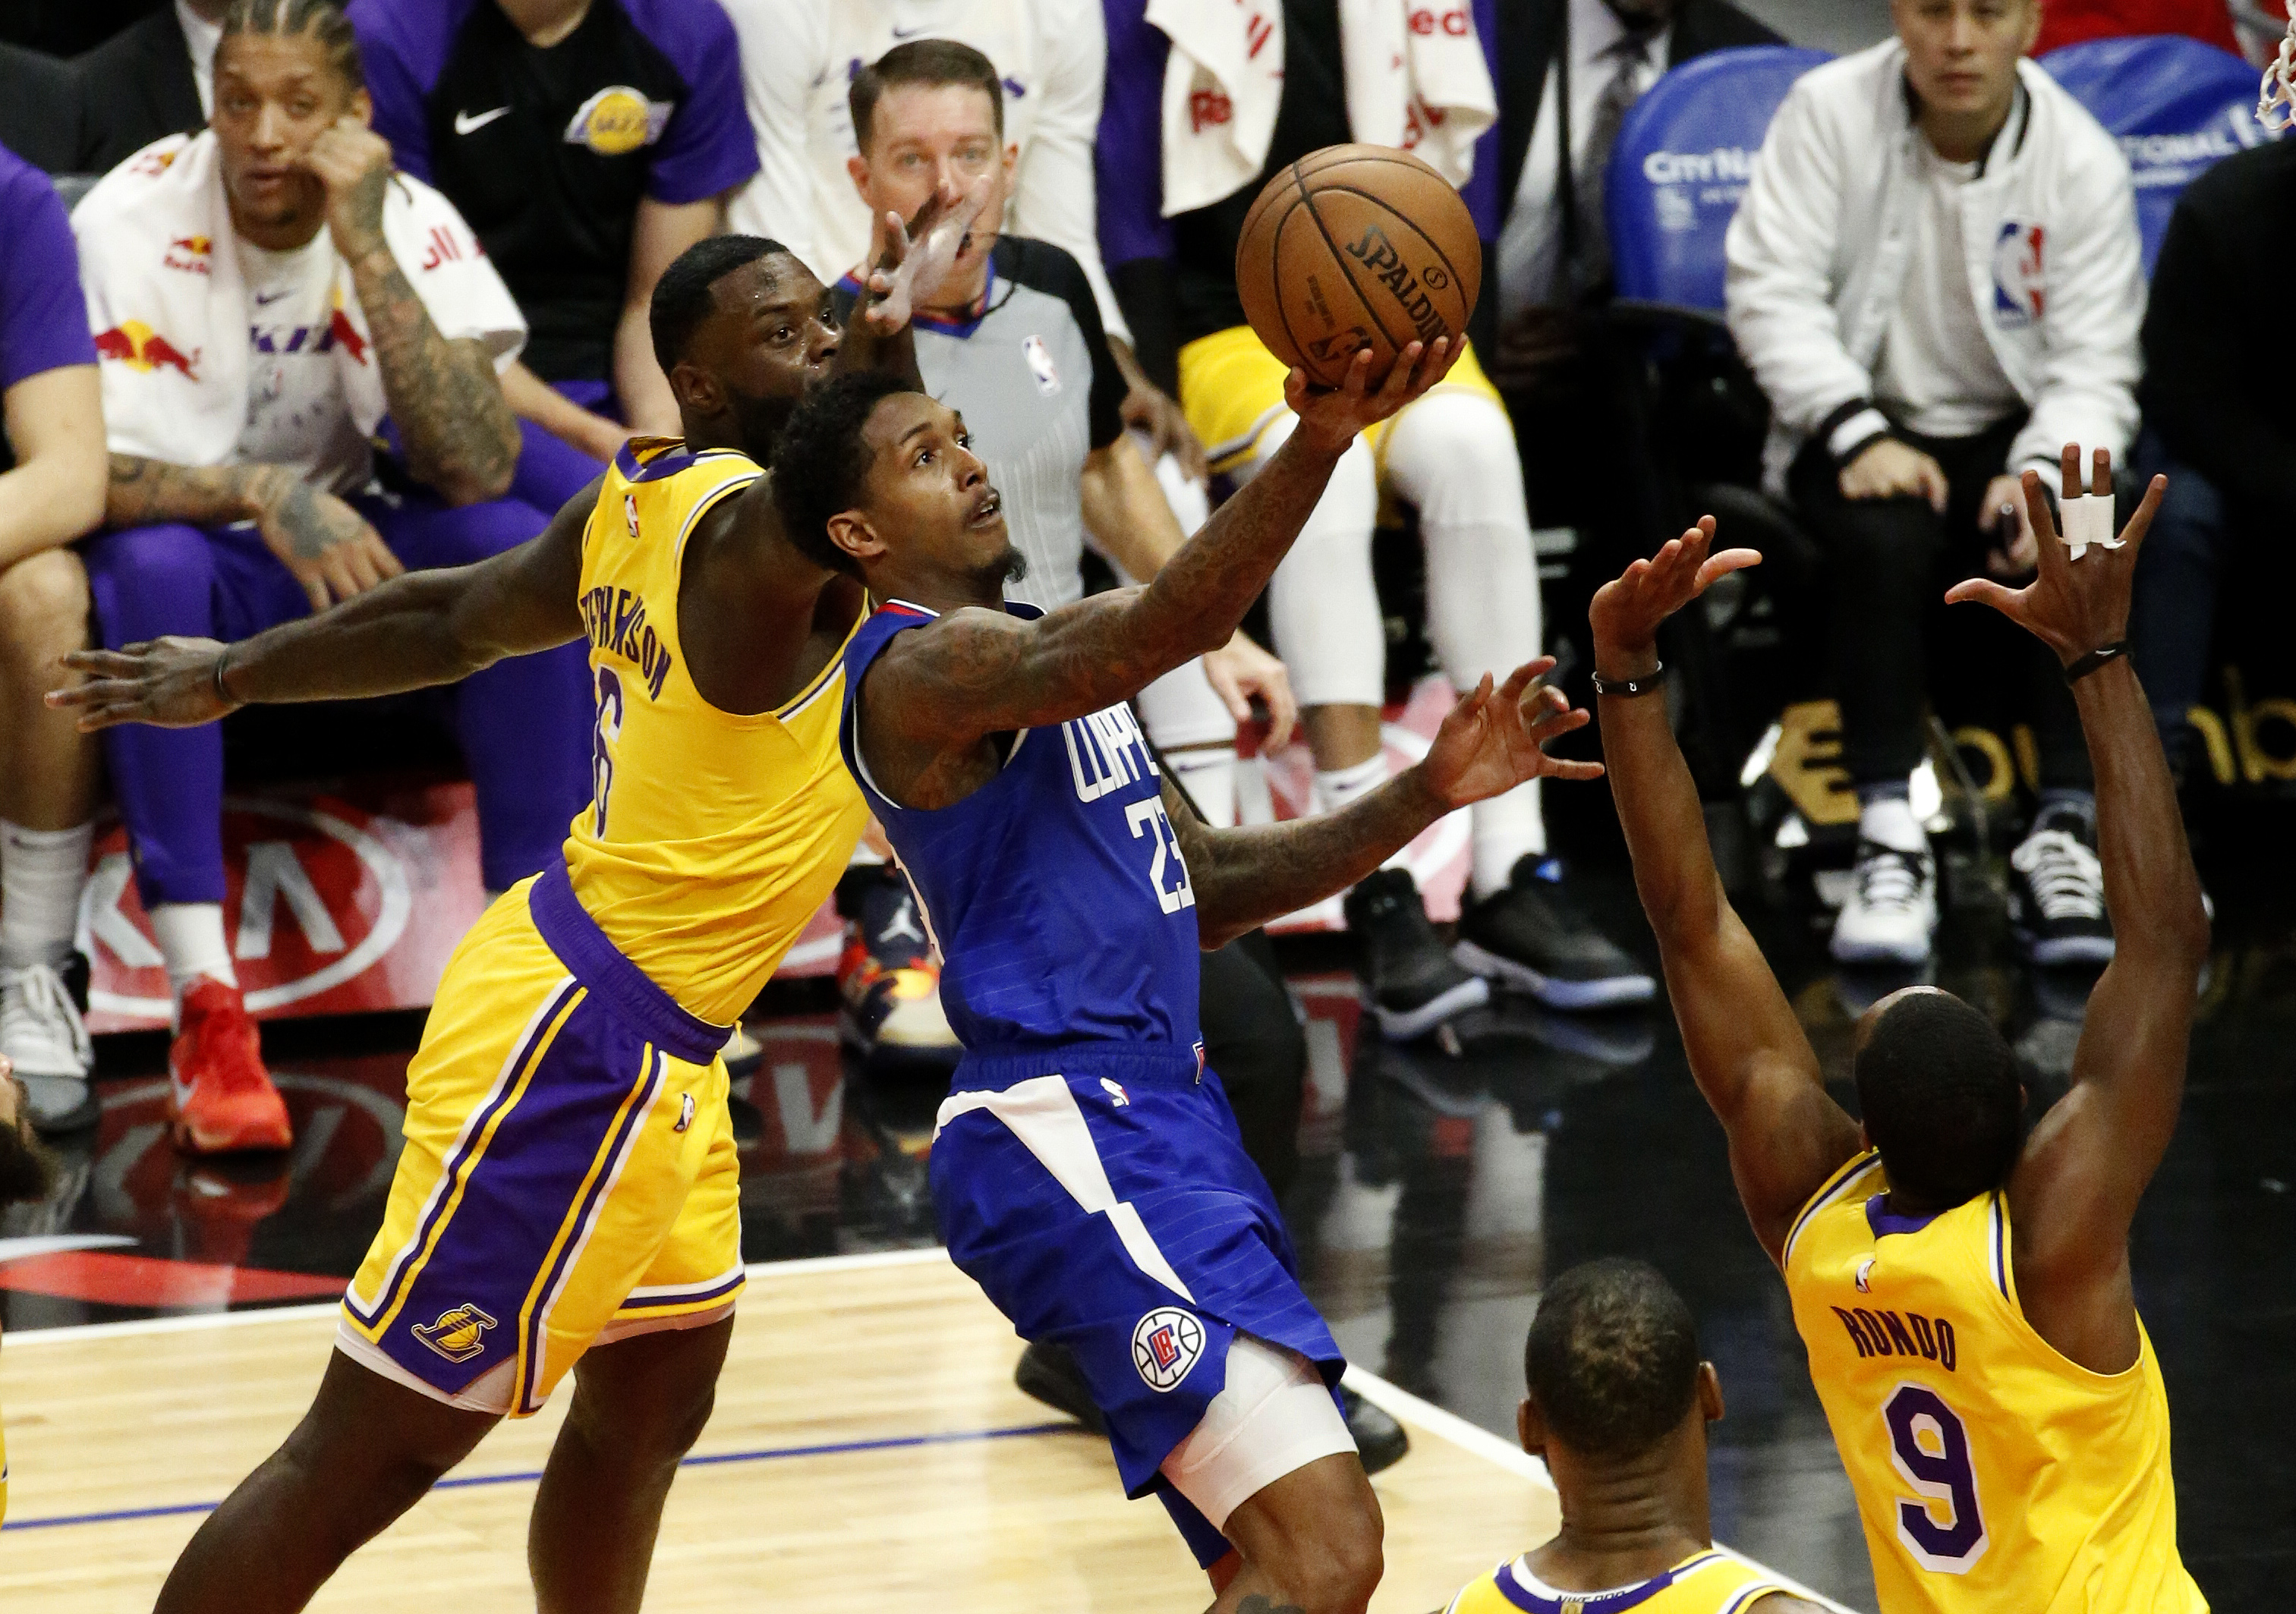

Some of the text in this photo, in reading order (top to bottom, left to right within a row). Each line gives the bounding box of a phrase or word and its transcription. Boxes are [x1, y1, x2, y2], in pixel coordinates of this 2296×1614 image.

[1345, 223, 1453, 346] SPALDIN
[1124, 794, 1195, 915] 23
[1831, 1305, 1957, 1372] RONDO
[1881, 1380, 1990, 1575] 9
